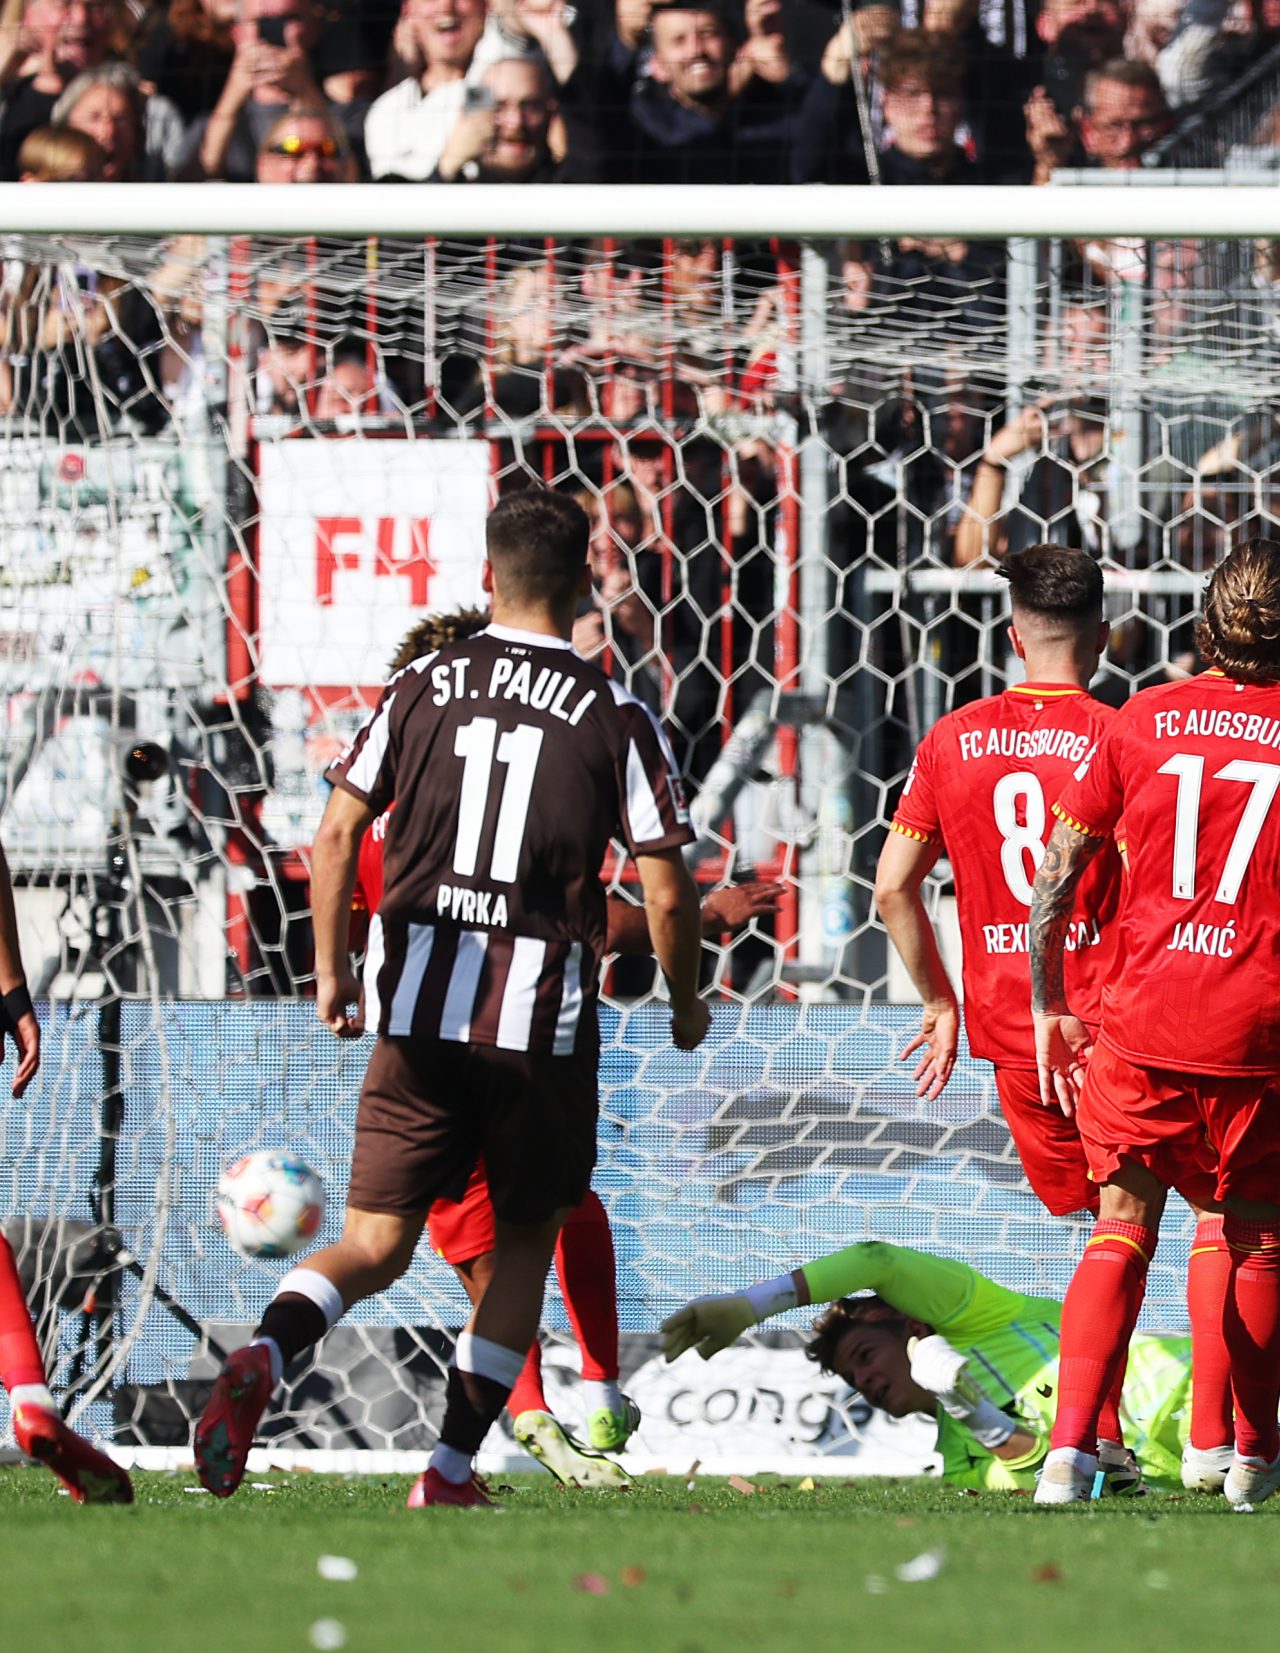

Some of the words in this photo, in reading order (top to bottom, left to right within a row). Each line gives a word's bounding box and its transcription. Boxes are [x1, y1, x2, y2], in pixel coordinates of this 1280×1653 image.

[314, 516, 438, 606] F4
[431, 658, 480, 707] ST.
[488, 658, 598, 727] PAULI
[959, 730, 983, 761] FC
[986, 728, 1090, 763] AUGSBURG
[1154, 709, 1181, 739] FC
[453, 716, 545, 884] 11
[993, 771, 1047, 907] 8
[436, 884, 509, 928] PYRKA
[982, 918, 1101, 954] REXCAJ
[1166, 918, 1237, 958] JAKIĆ
